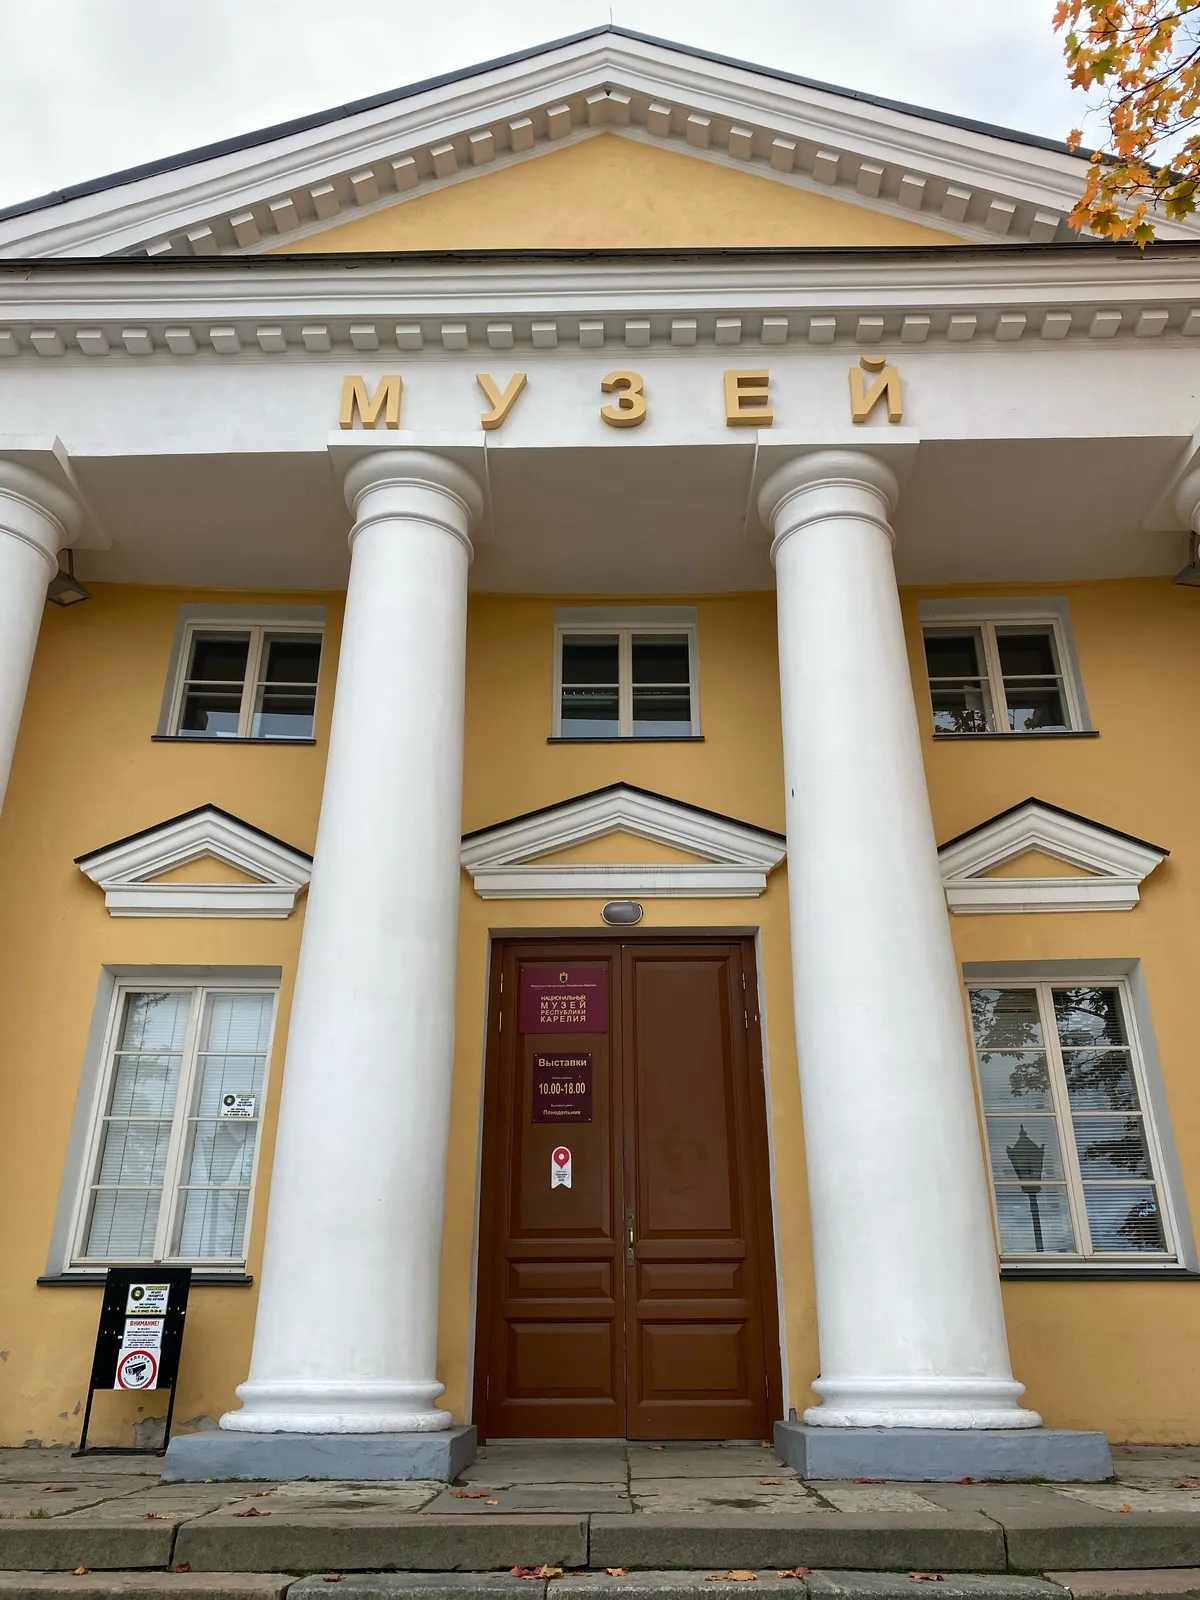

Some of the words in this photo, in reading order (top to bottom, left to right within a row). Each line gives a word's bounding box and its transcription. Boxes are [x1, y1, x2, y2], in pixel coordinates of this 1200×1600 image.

[338, 353, 903, 430] МУЗЕЙ
[540, 994, 587, 1002] НАЦИОНАЛЬНЫЙ
[540, 1000, 587, 1009] МУЗЕЙ
[540, 1015, 587, 1023] КАРЕЛИЯ
[538, 1058, 587, 1067] Выставки
[538, 1082, 586, 1095] 10.00-18.00
